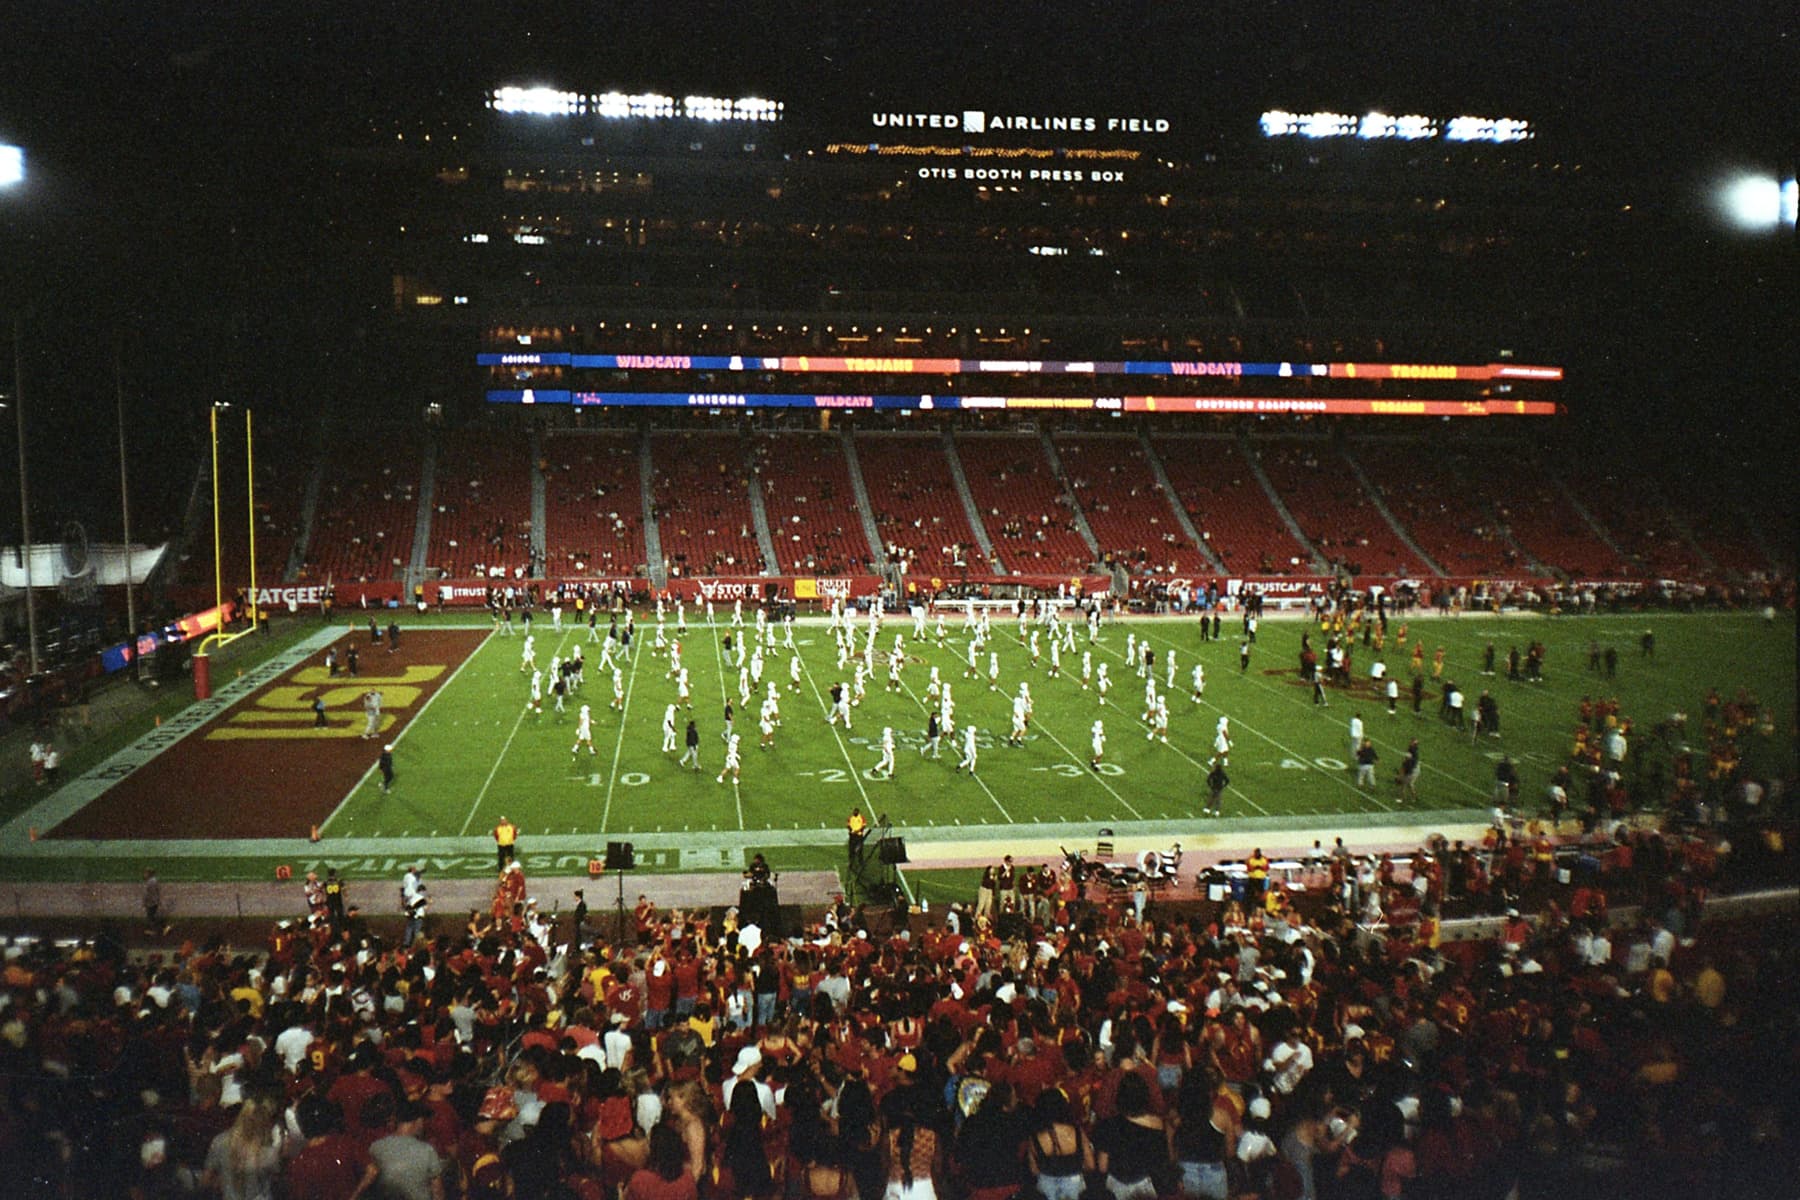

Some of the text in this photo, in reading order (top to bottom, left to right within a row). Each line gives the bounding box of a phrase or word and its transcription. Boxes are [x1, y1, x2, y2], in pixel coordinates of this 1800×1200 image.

[872, 112, 1170, 133] UNITED AIRLINES FIELD
[918, 167, 1124, 182] OTIS BOOTH PRESS BOX
[615, 355, 691, 369] WILDCATS
[1171, 362, 1242, 376] WILDCATS
[814, 396, 873, 407] WILDCATS
[585, 772, 651, 787] 10
